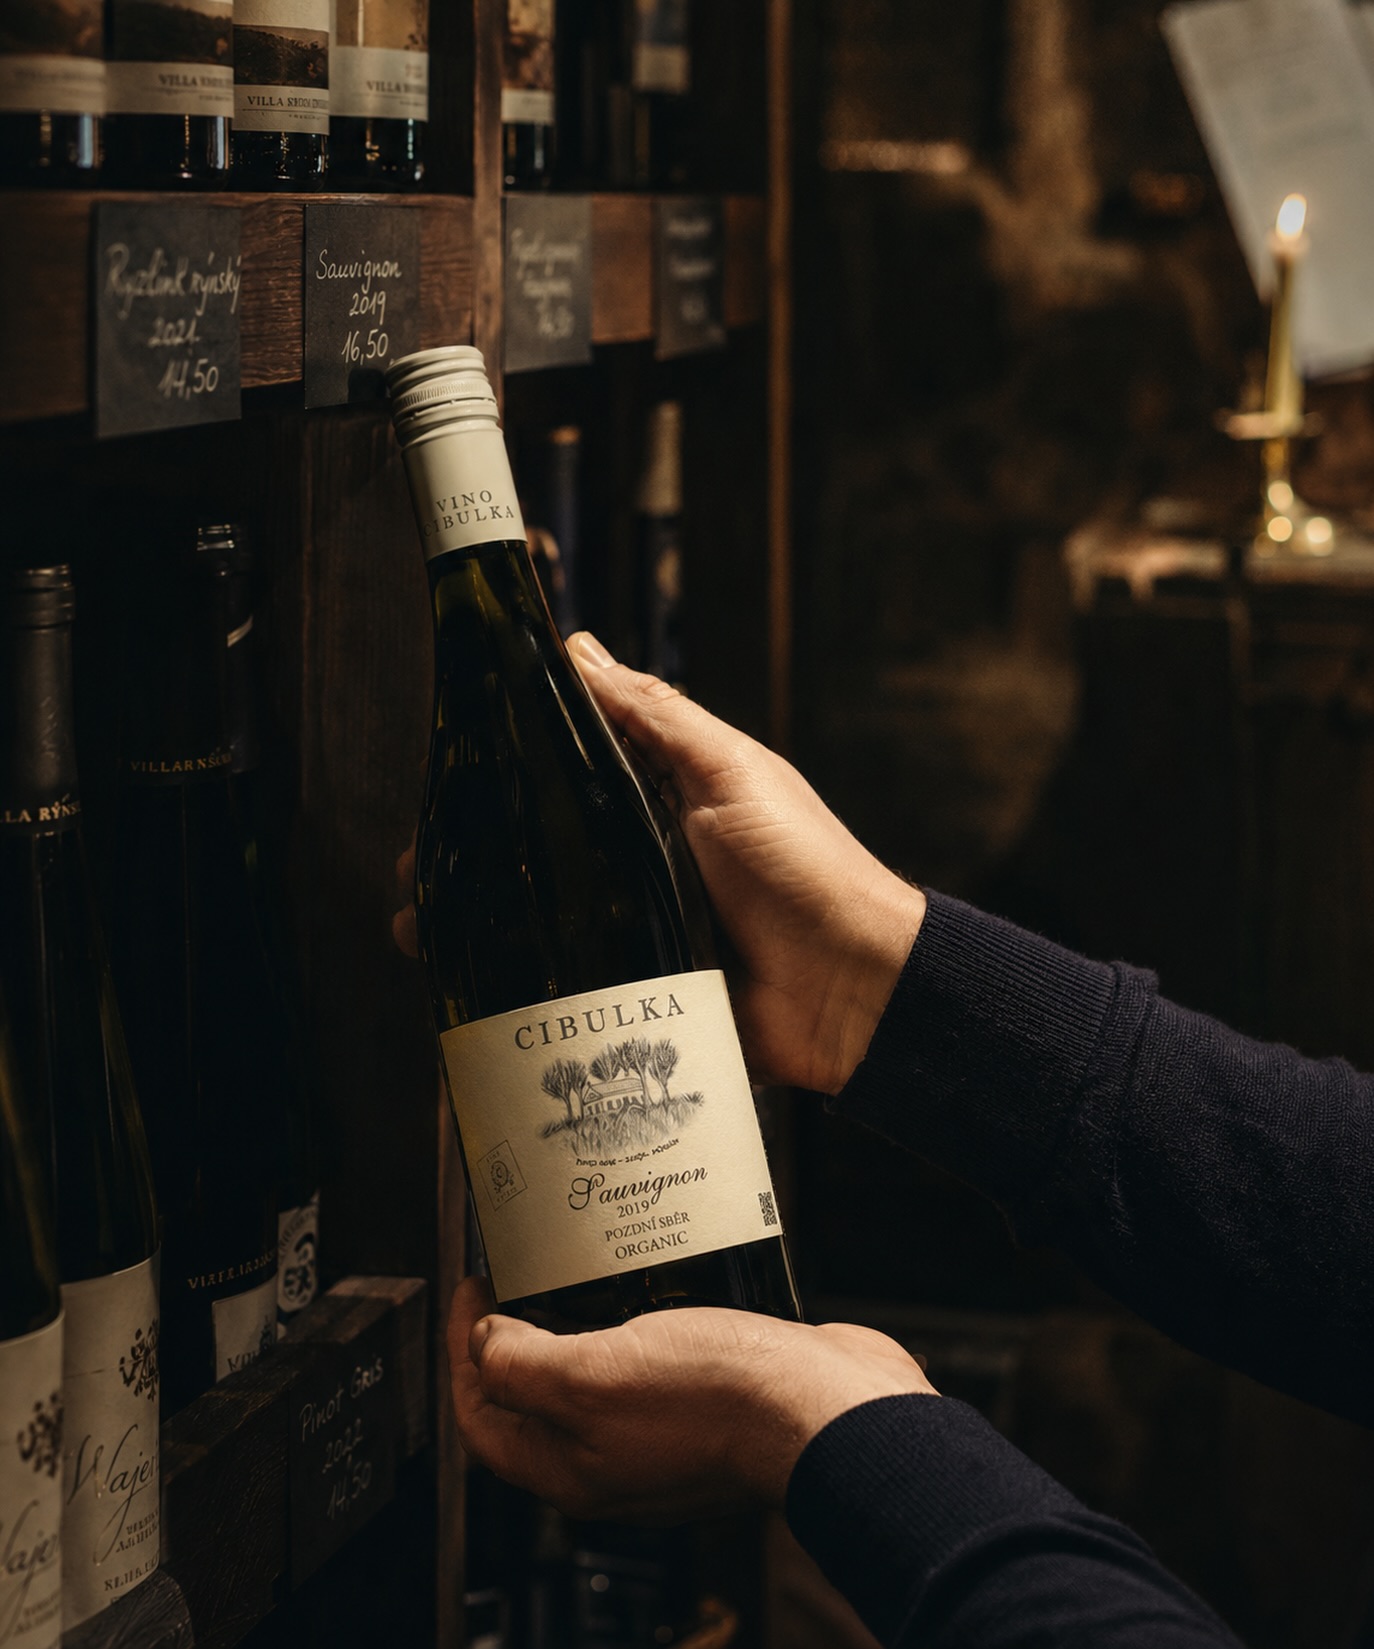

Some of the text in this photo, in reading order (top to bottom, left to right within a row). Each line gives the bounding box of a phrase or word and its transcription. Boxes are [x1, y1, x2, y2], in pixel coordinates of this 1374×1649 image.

[247, 95, 284, 106] VILLA
[316, 249, 403, 295] Sauvignon
[349, 290, 386, 326] 2019
[341, 328, 389, 366] 16,50
[436, 490, 492, 513] VINO
[423, 505, 515, 537] CIBULKA
[514, 993, 685, 1050] CIBULKA
[568, 1167, 708, 1211] Sauvignon
[617, 1200, 650, 1219] 2019
[605, 1215, 657, 1242] POZDNÍ
[615, 1230, 689, 1260] ORGANIC
